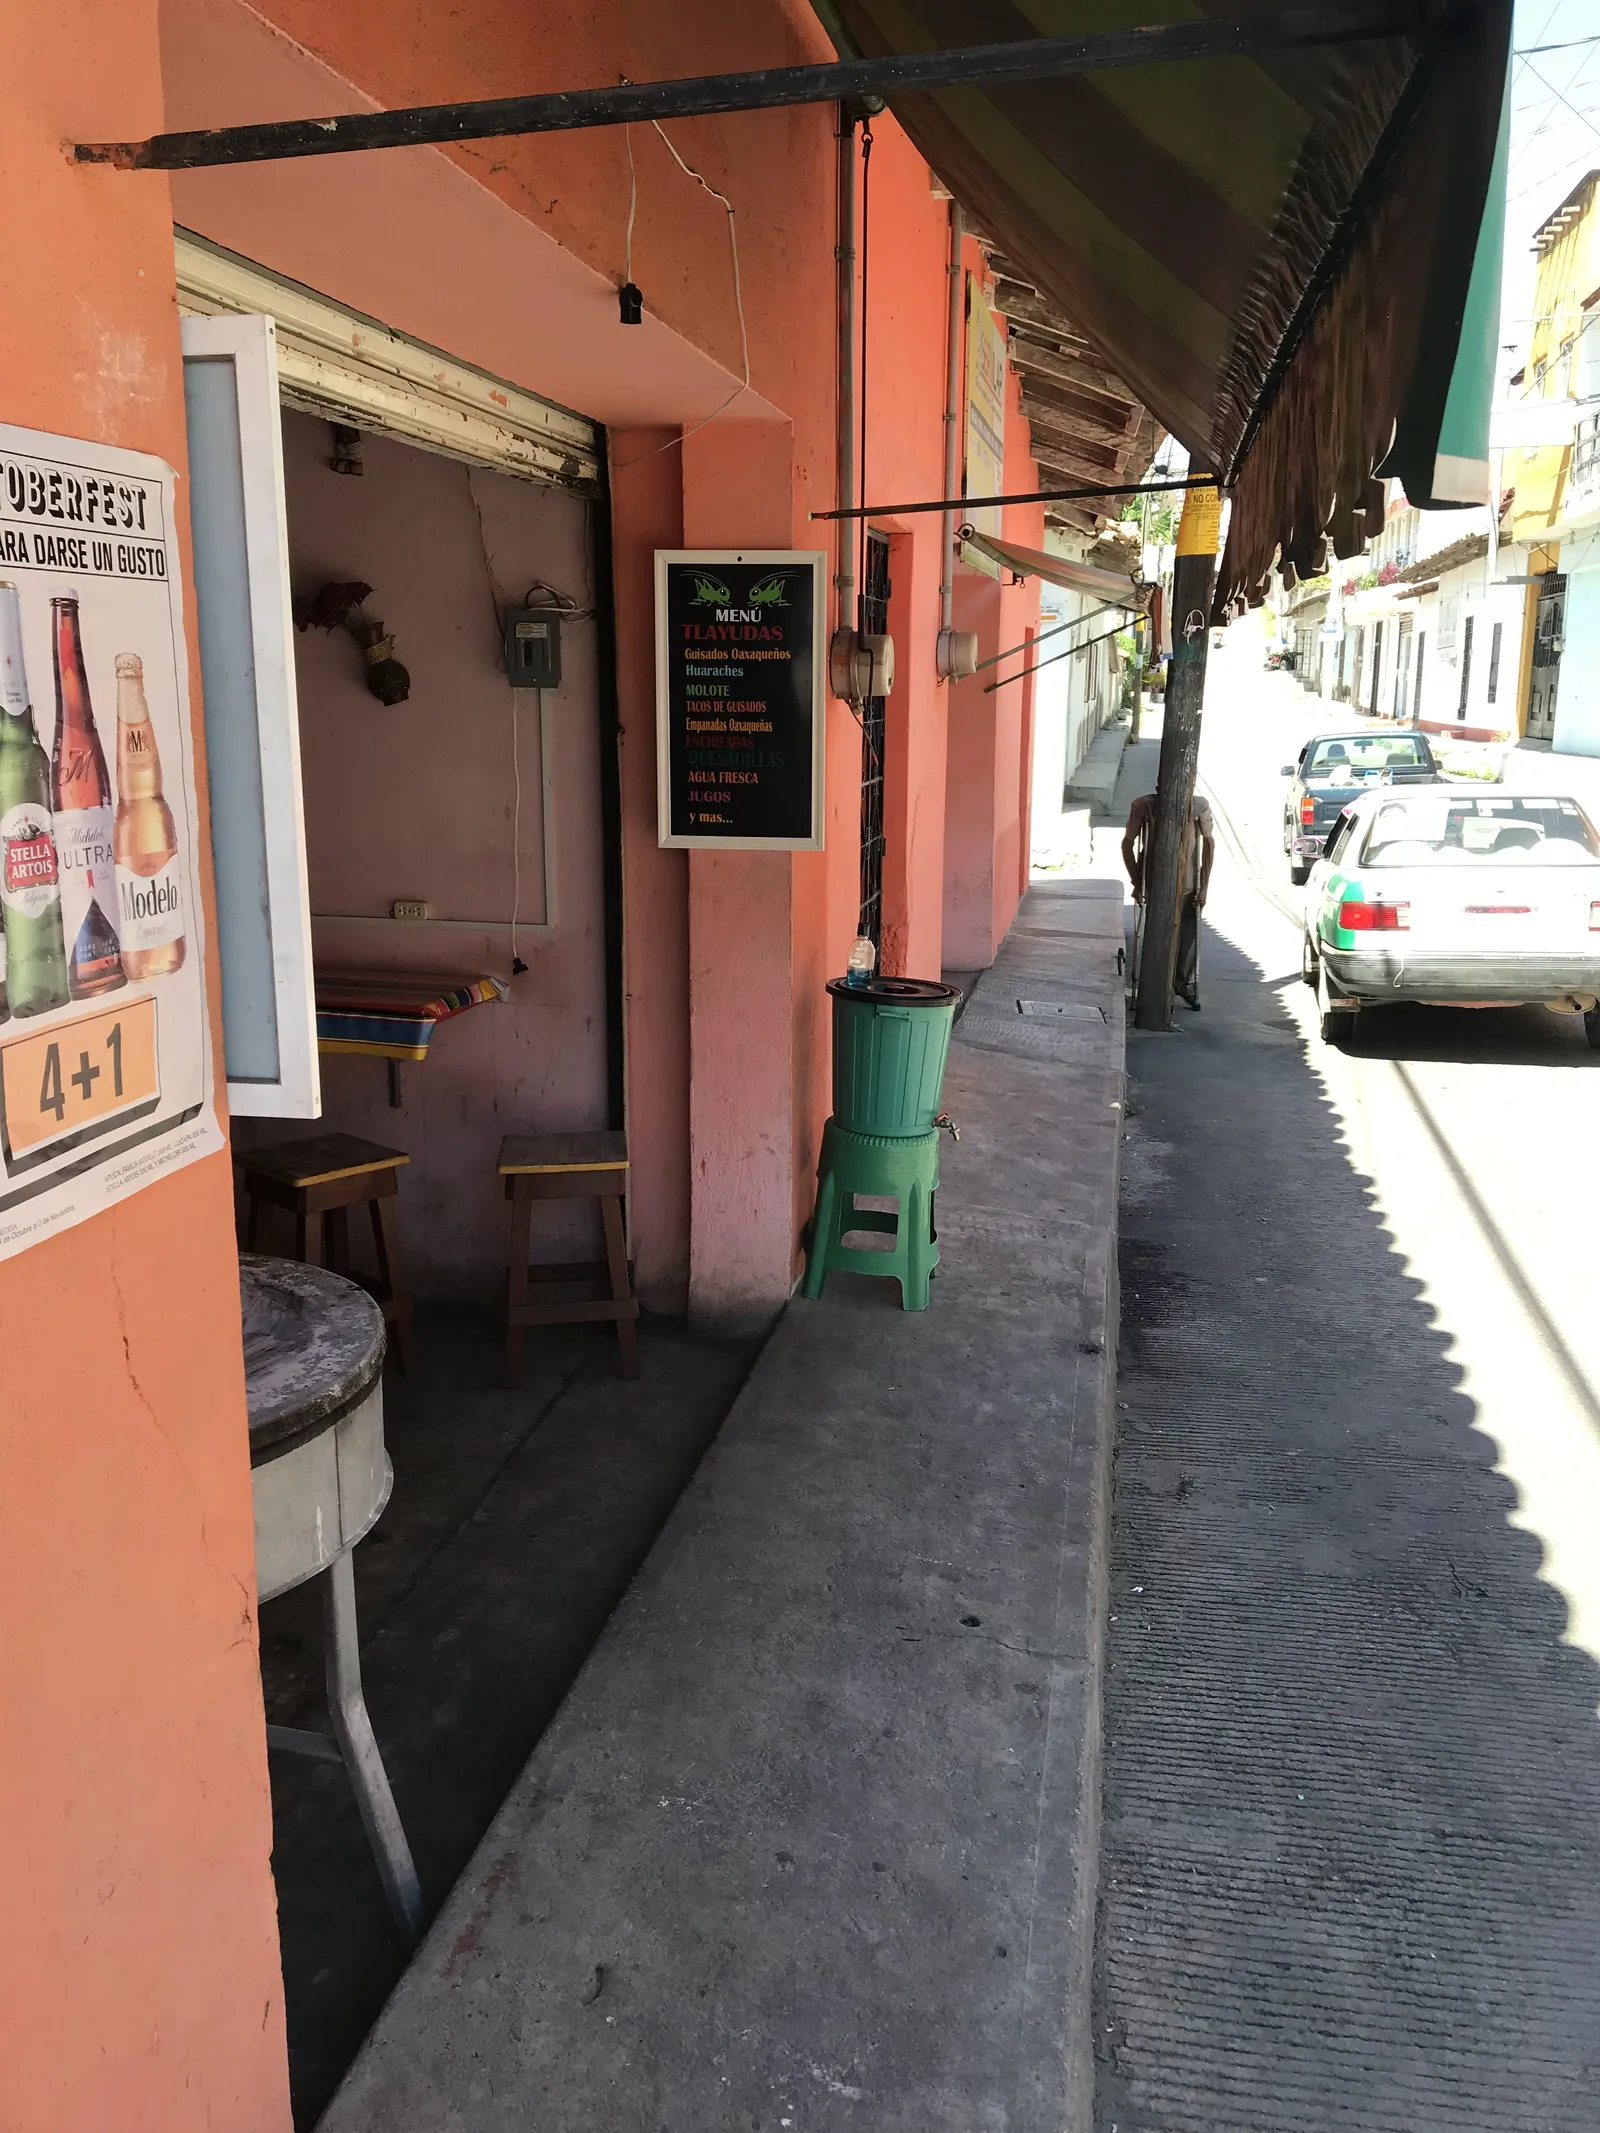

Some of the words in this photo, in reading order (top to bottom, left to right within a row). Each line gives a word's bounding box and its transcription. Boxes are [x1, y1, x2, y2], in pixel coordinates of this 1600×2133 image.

[0, 459, 146, 531] OBERFEST
[1194, 494, 1203, 504] NO
[33, 533, 89, 569] DARSE
[92, 540, 113, 572] UN
[117, 544, 165, 577] GUSTO
[715, 606, 762, 623] MENÚ
[681, 624, 784, 642] TLAYUDAS
[685, 647, 728, 661] Guisados
[731, 647, 792, 662] Oaxaqueños
[685, 664, 744, 677] Huaraches
[685, 684, 730, 697] MOLOTE
[686, 701, 712, 713] TACOS
[714, 701, 725, 713] DE
[727, 701, 767, 713] GUISADOS
[686, 717, 727, 733] Empanadas
[729, 718, 773, 734] Oaxaqueñas
[685, 734, 755, 750] ENCHILADAS
[687, 750, 786, 769] QUESADILLAS
[688, 771, 716, 784] AGUA
[719, 771, 759, 784] FRESCA
[688, 790, 731, 803] JUGOS
[688, 812, 696, 824] y
[10, 843, 51, 863] STELLA
[63, 843, 114, 870] ULTRA
[12, 859, 53, 879] ARTOIS
[121, 876, 177, 921] Modelo
[40, 1022, 124, 1122] 4+1
[137, 1150, 158, 1166] MODELO
[105, 1178, 124, 1194] STELLA
[124, 1170, 140, 1185] ARTOIS
[157, 1149, 181, 1167] MICHELOB
[11, 1225, 33, 1240] Octubre
